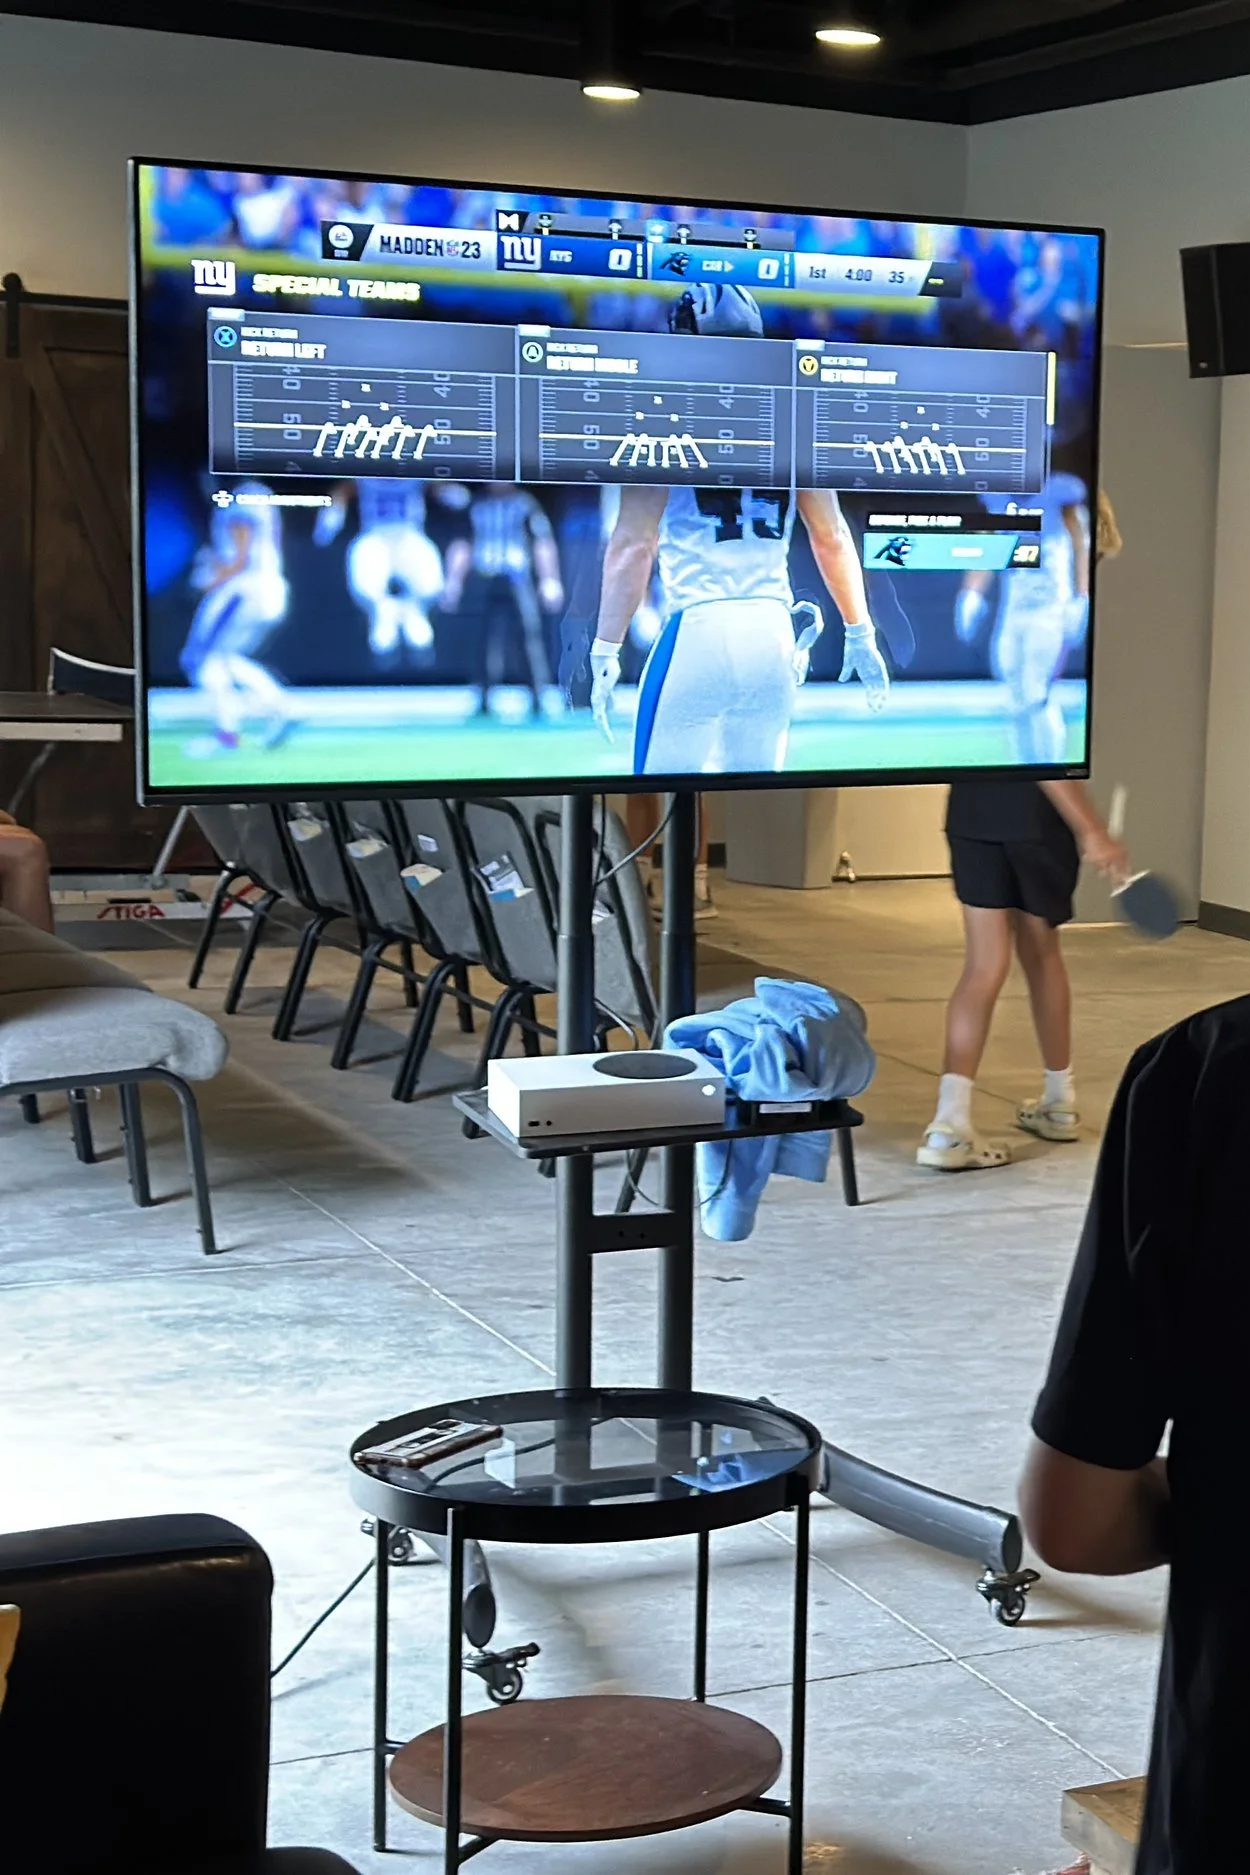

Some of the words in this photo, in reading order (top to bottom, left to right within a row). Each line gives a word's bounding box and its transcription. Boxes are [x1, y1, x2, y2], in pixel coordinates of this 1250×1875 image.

[379, 235, 444, 257] MADDEN
[461, 241, 481, 259] 23
[608, 248, 632, 271] 0
[757, 258, 780, 280] 0
[808, 265, 827, 279] 1st
[888, 271, 905, 284] 35
[252, 273, 343, 297] SPECIAL
[347, 278, 421, 302] TEAMS
[97, 905, 165, 919] STIGA
